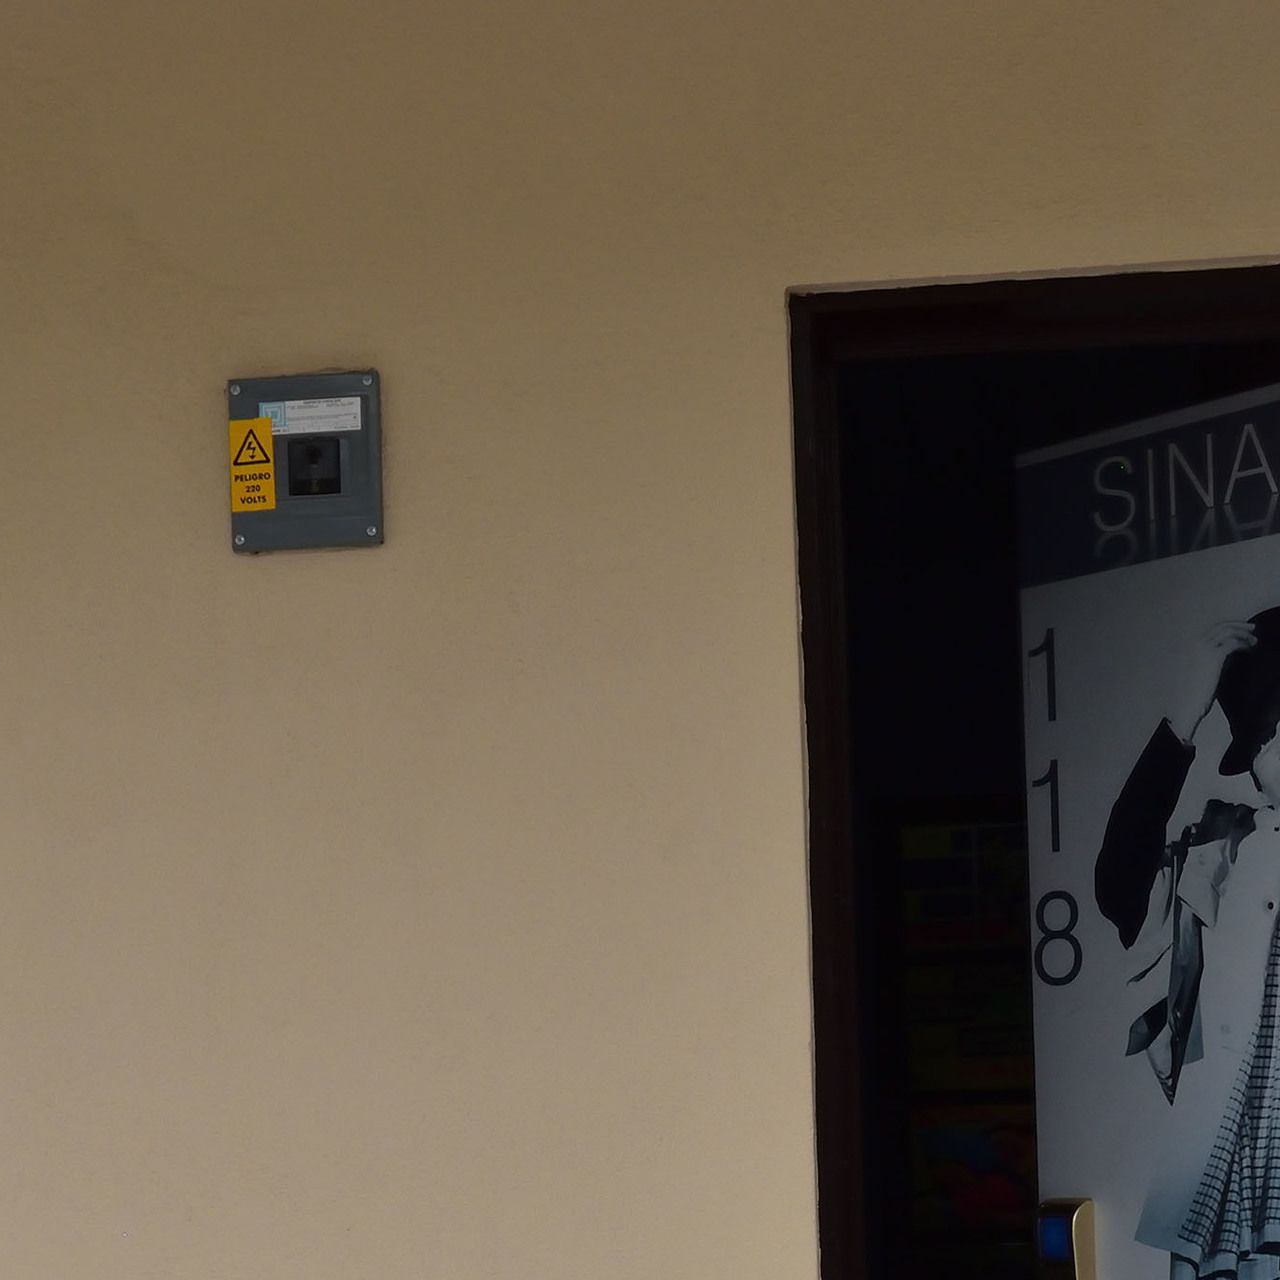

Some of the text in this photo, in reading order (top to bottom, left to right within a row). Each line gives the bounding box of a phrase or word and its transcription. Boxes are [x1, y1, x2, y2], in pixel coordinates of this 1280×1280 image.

[233, 472, 271, 482] PELIGRO
[245, 484, 261, 493] 220
[240, 495, 267, 504] VOLTS
